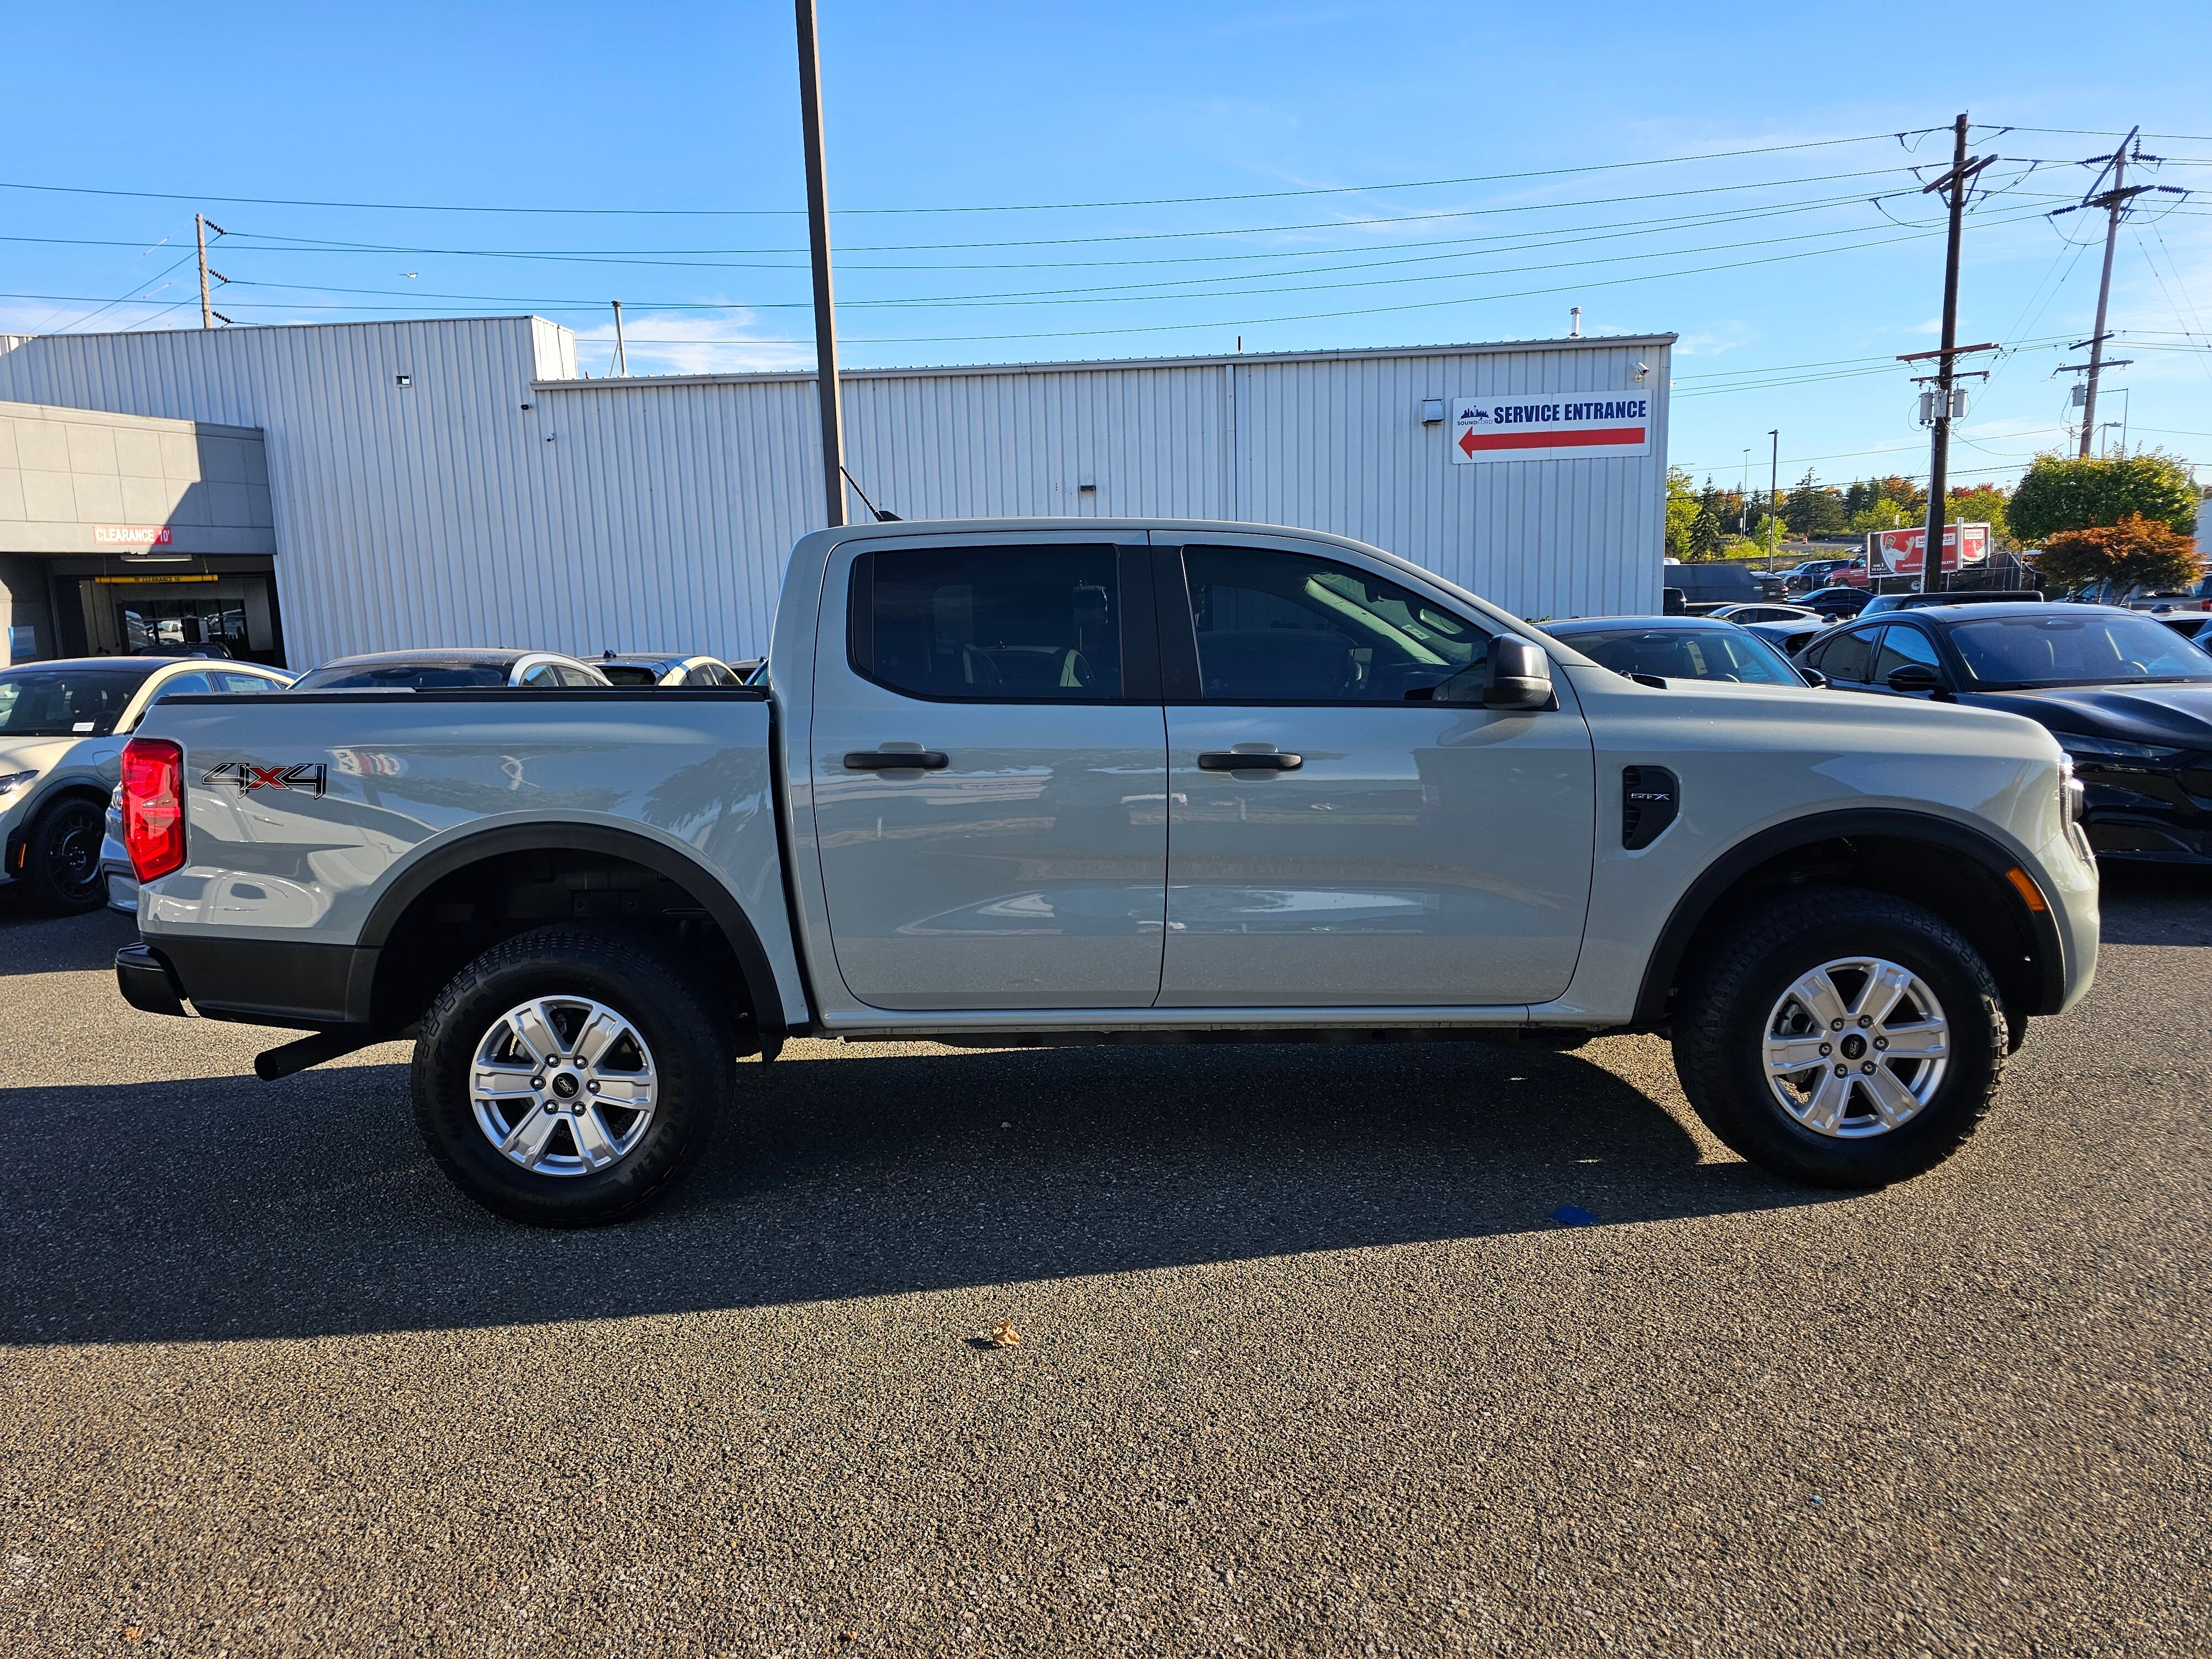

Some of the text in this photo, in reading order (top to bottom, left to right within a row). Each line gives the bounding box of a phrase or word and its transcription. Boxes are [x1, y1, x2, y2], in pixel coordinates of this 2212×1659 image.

[1494, 400, 1646, 424] SERVICE ENTRANCE
[96, 528, 155, 542] CLEARANCE
[560, 1079, 572, 1091] Ford
